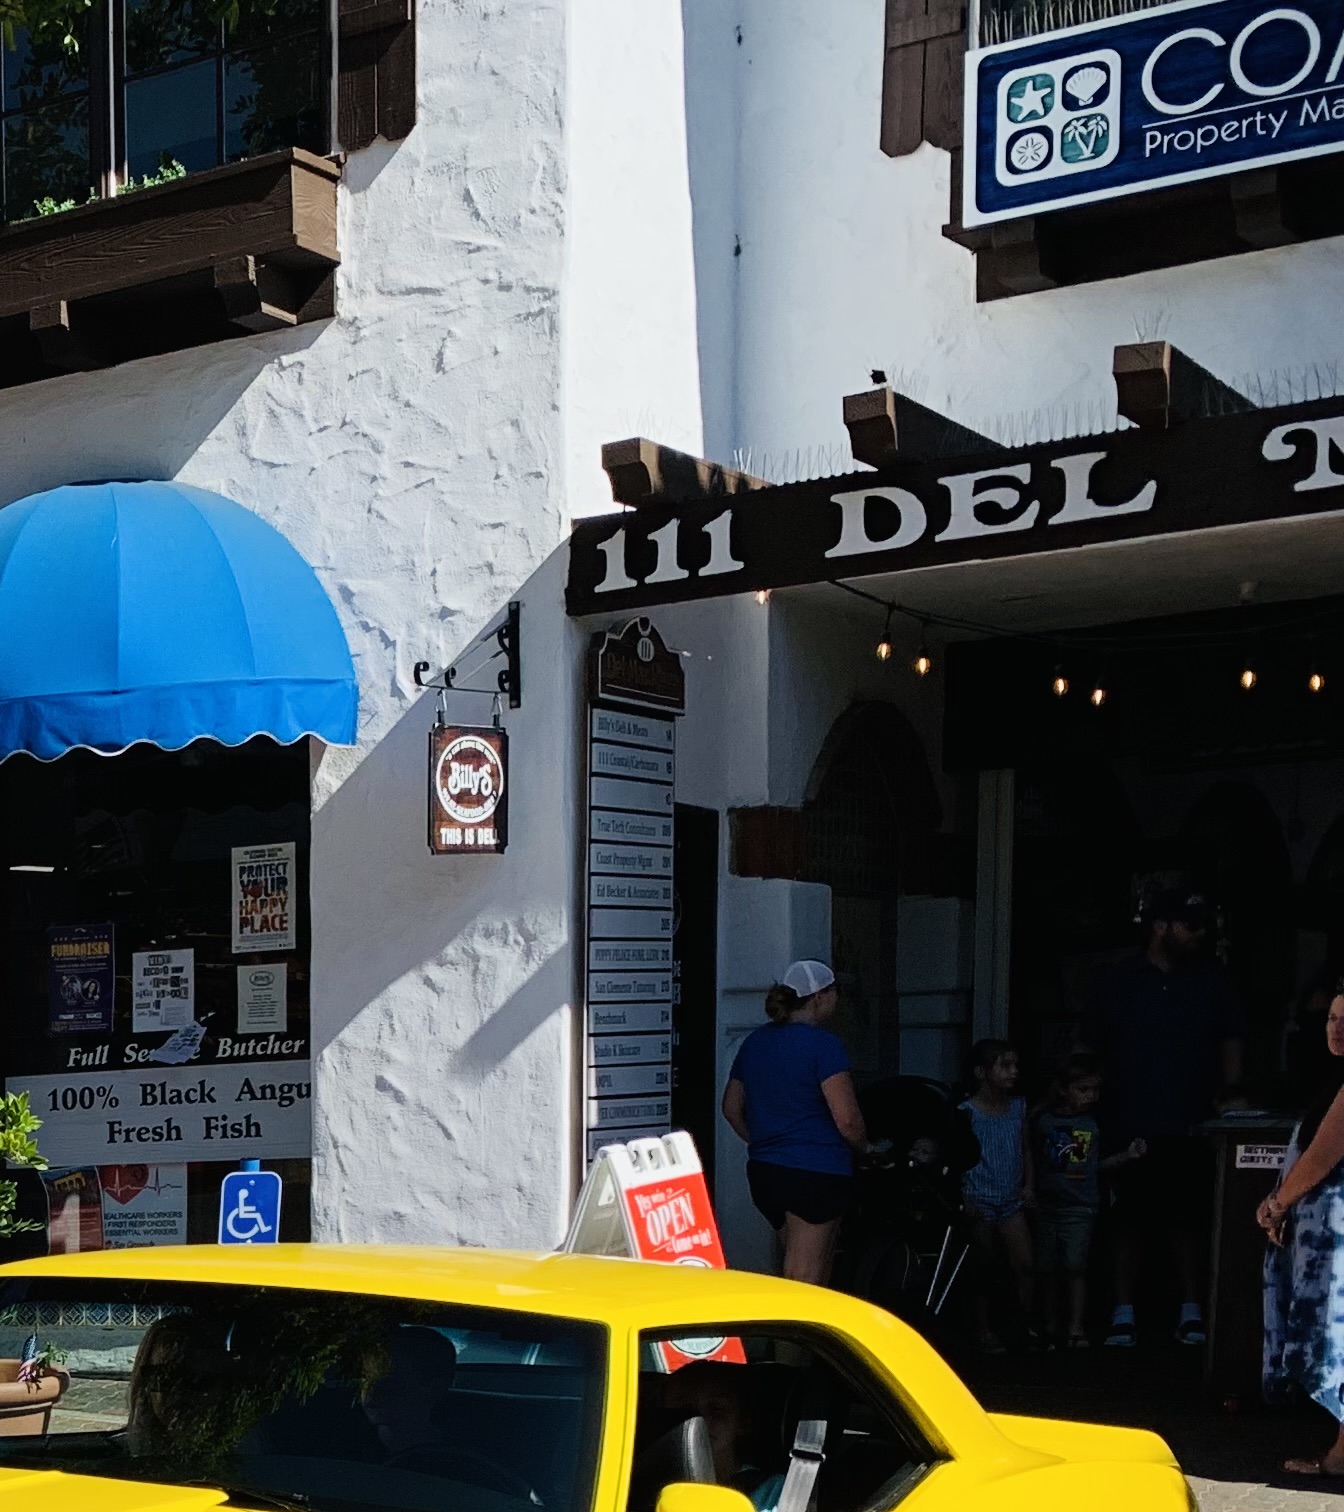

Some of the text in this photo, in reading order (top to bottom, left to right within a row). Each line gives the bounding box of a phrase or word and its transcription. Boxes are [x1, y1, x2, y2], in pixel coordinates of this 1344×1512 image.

[1145, 109, 1288, 157] Property
[594, 508, 745, 594] 111
[824, 450, 1158, 560] DEL
[641, 640, 651, 660] 111
[440, 827, 462, 846] THIS
[464, 827, 475, 845] IS
[238, 862, 288, 880] PROTECT
[239, 876, 289, 899] YOUR
[238, 897, 289, 916] HAPPY
[238, 913, 289, 935] PLACE
[66, 1045, 109, 1067] Full
[216, 1034, 306, 1059] Butcher
[47, 1077, 310, 1111] 100% Black Angu
[107, 1113, 263, 1145] Fresh Fish
[147, 1211, 183, 1219] WORKERS
[646, 1192, 696, 1247] OPEN
